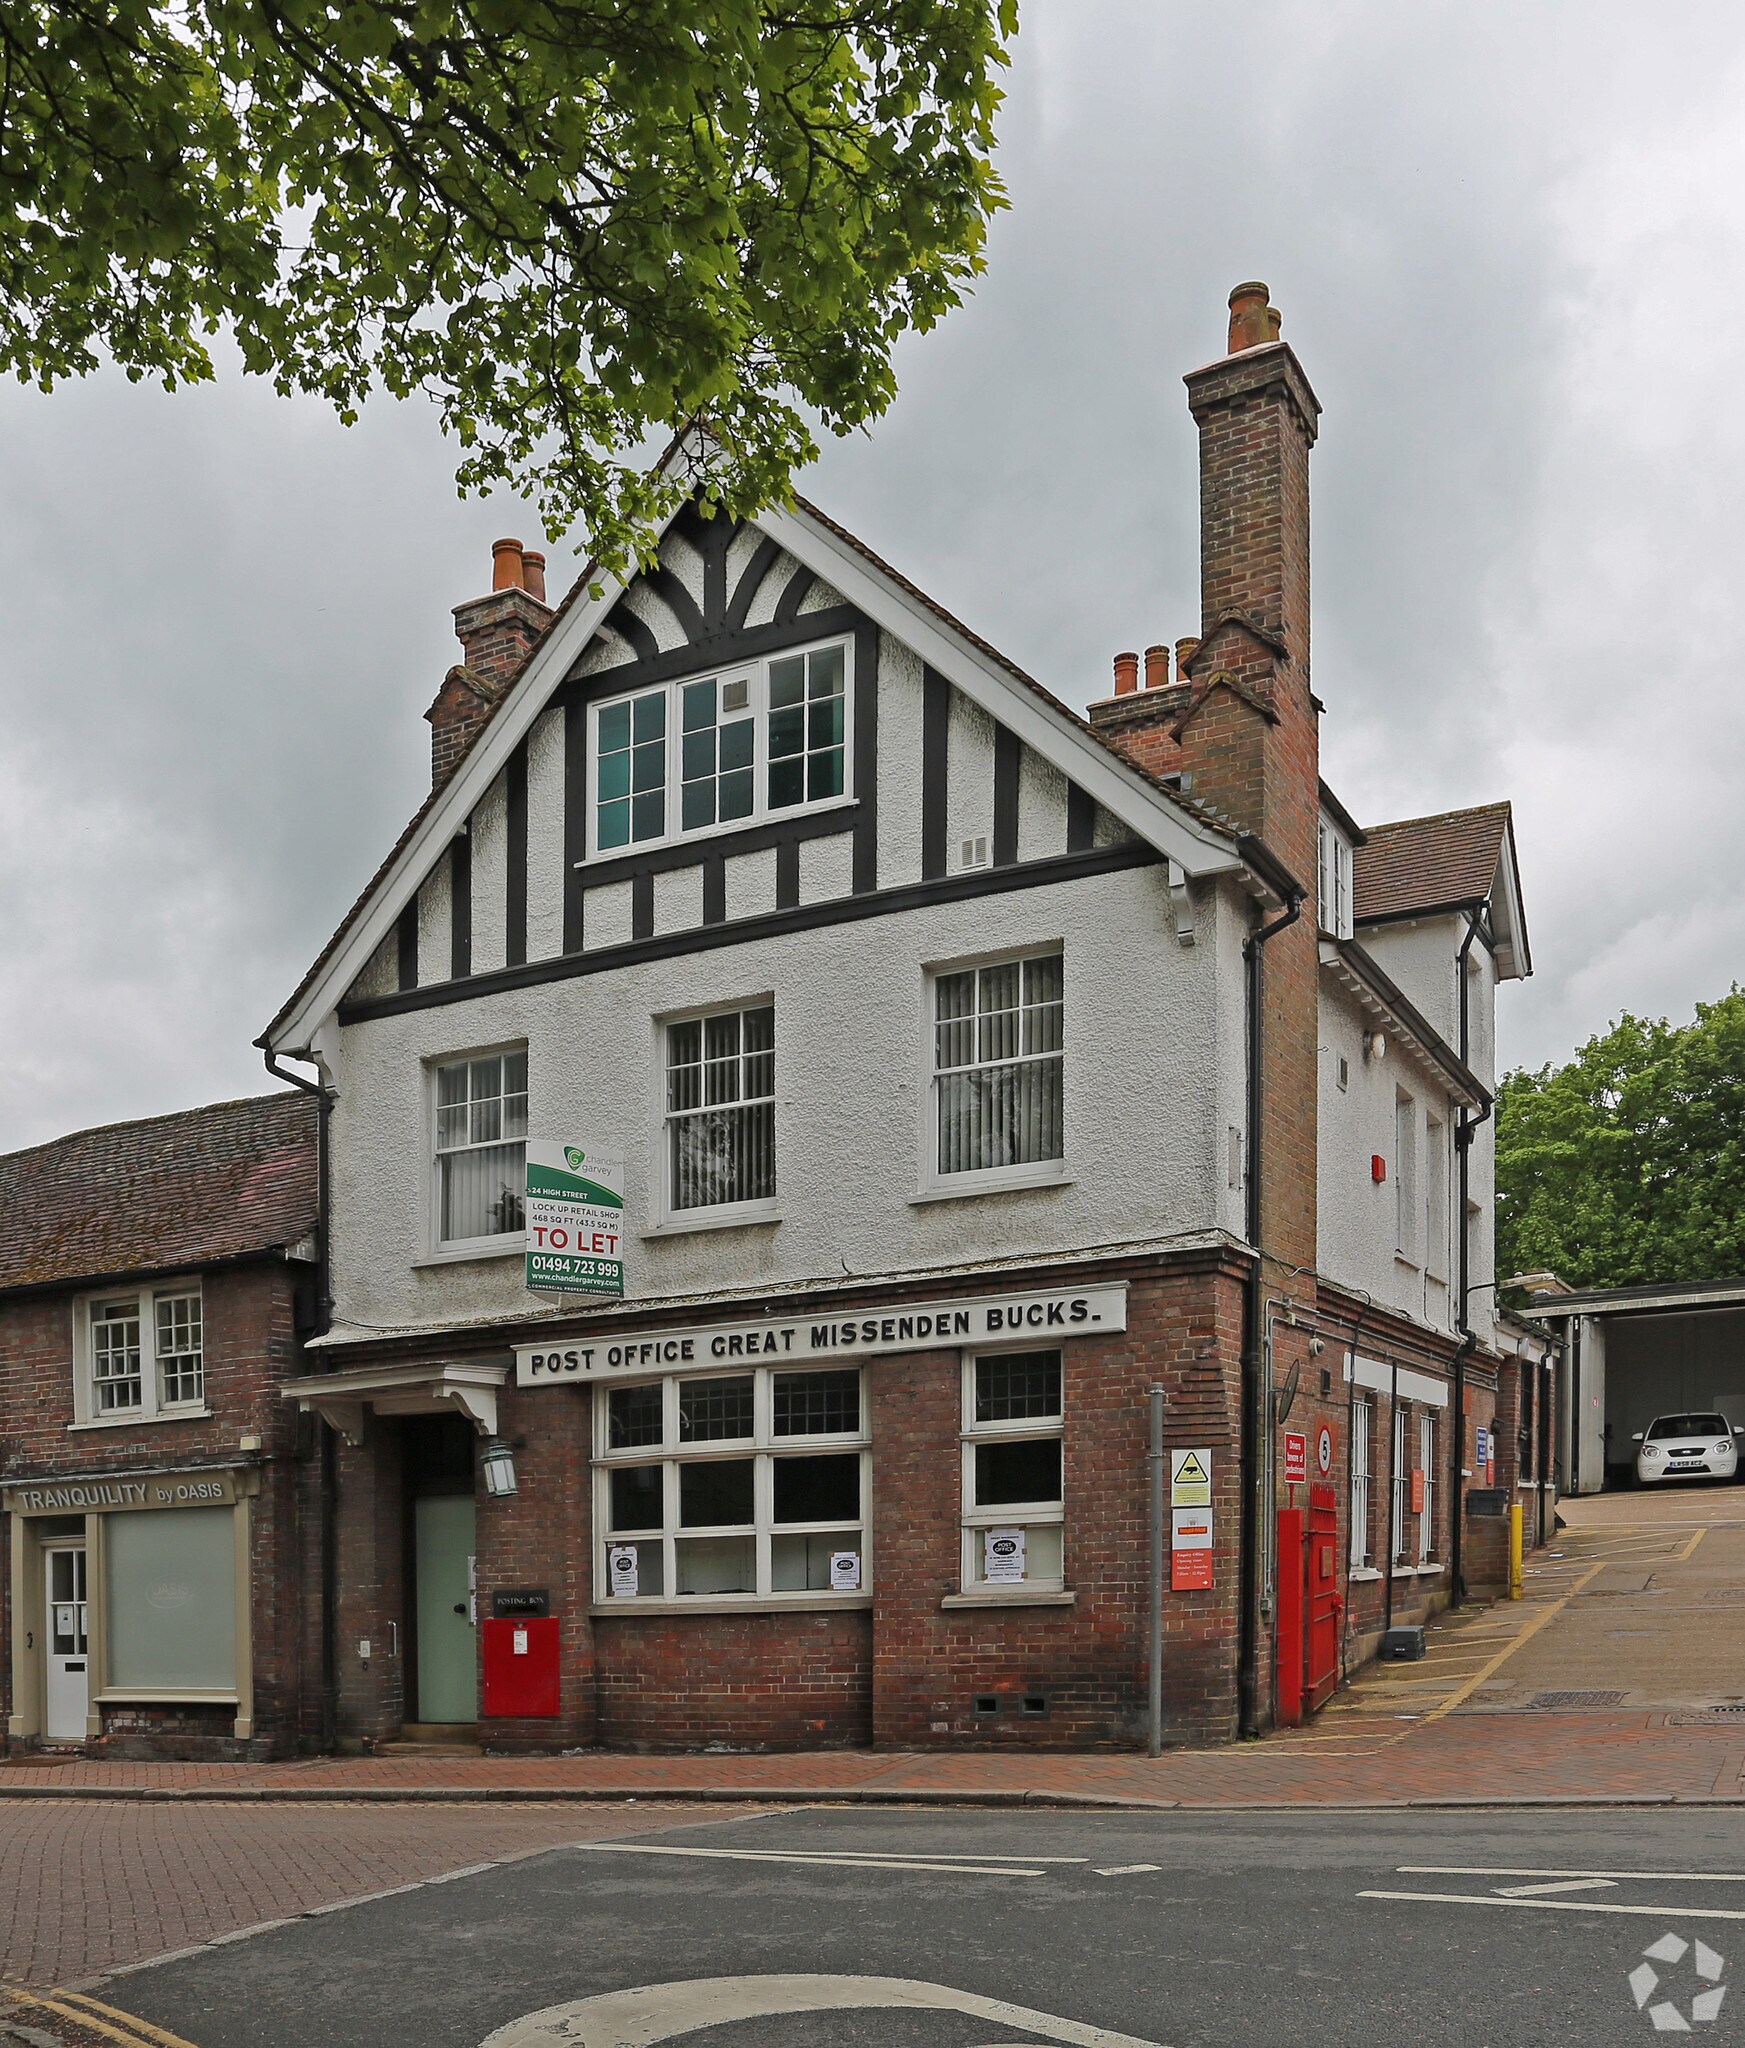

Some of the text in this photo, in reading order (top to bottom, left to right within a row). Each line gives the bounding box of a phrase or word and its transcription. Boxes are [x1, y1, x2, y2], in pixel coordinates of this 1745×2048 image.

[586, 1155, 622, 1167] chandler
[582, 1164, 612, 1176] garvey
[542, 1188, 561, 1196] HIGH
[562, 1190, 588, 1200] STREET
[532, 1203, 556, 1212] LOCK
[571, 1207, 598, 1217] RETAIL
[600, 1211, 620, 1220] SHOP
[532, 1214, 548, 1222] 468
[550, 1216, 561, 1224] SQ
[576, 1219, 596, 1228] (43.5
[597, 1221, 608, 1229] SQ
[609, 1223, 619, 1231] M)
[533, 1226, 619, 1255] TO LET
[532, 1255, 619, 1278] 01494 723 999
[531, 1273, 620, 1287] www.chandlergarvey.com
[589, 1288, 620, 1296] CONSULTANTS
[531, 1299, 1102, 1375] POST OFFICE GREAT MISSENDEN BUCKS.
[1322, 1440, 1328, 1461] 5
[18, 1482, 223, 1509] TRANQUILITY by OASIS
[497, 1596, 544, 1605] POSTING BOX
